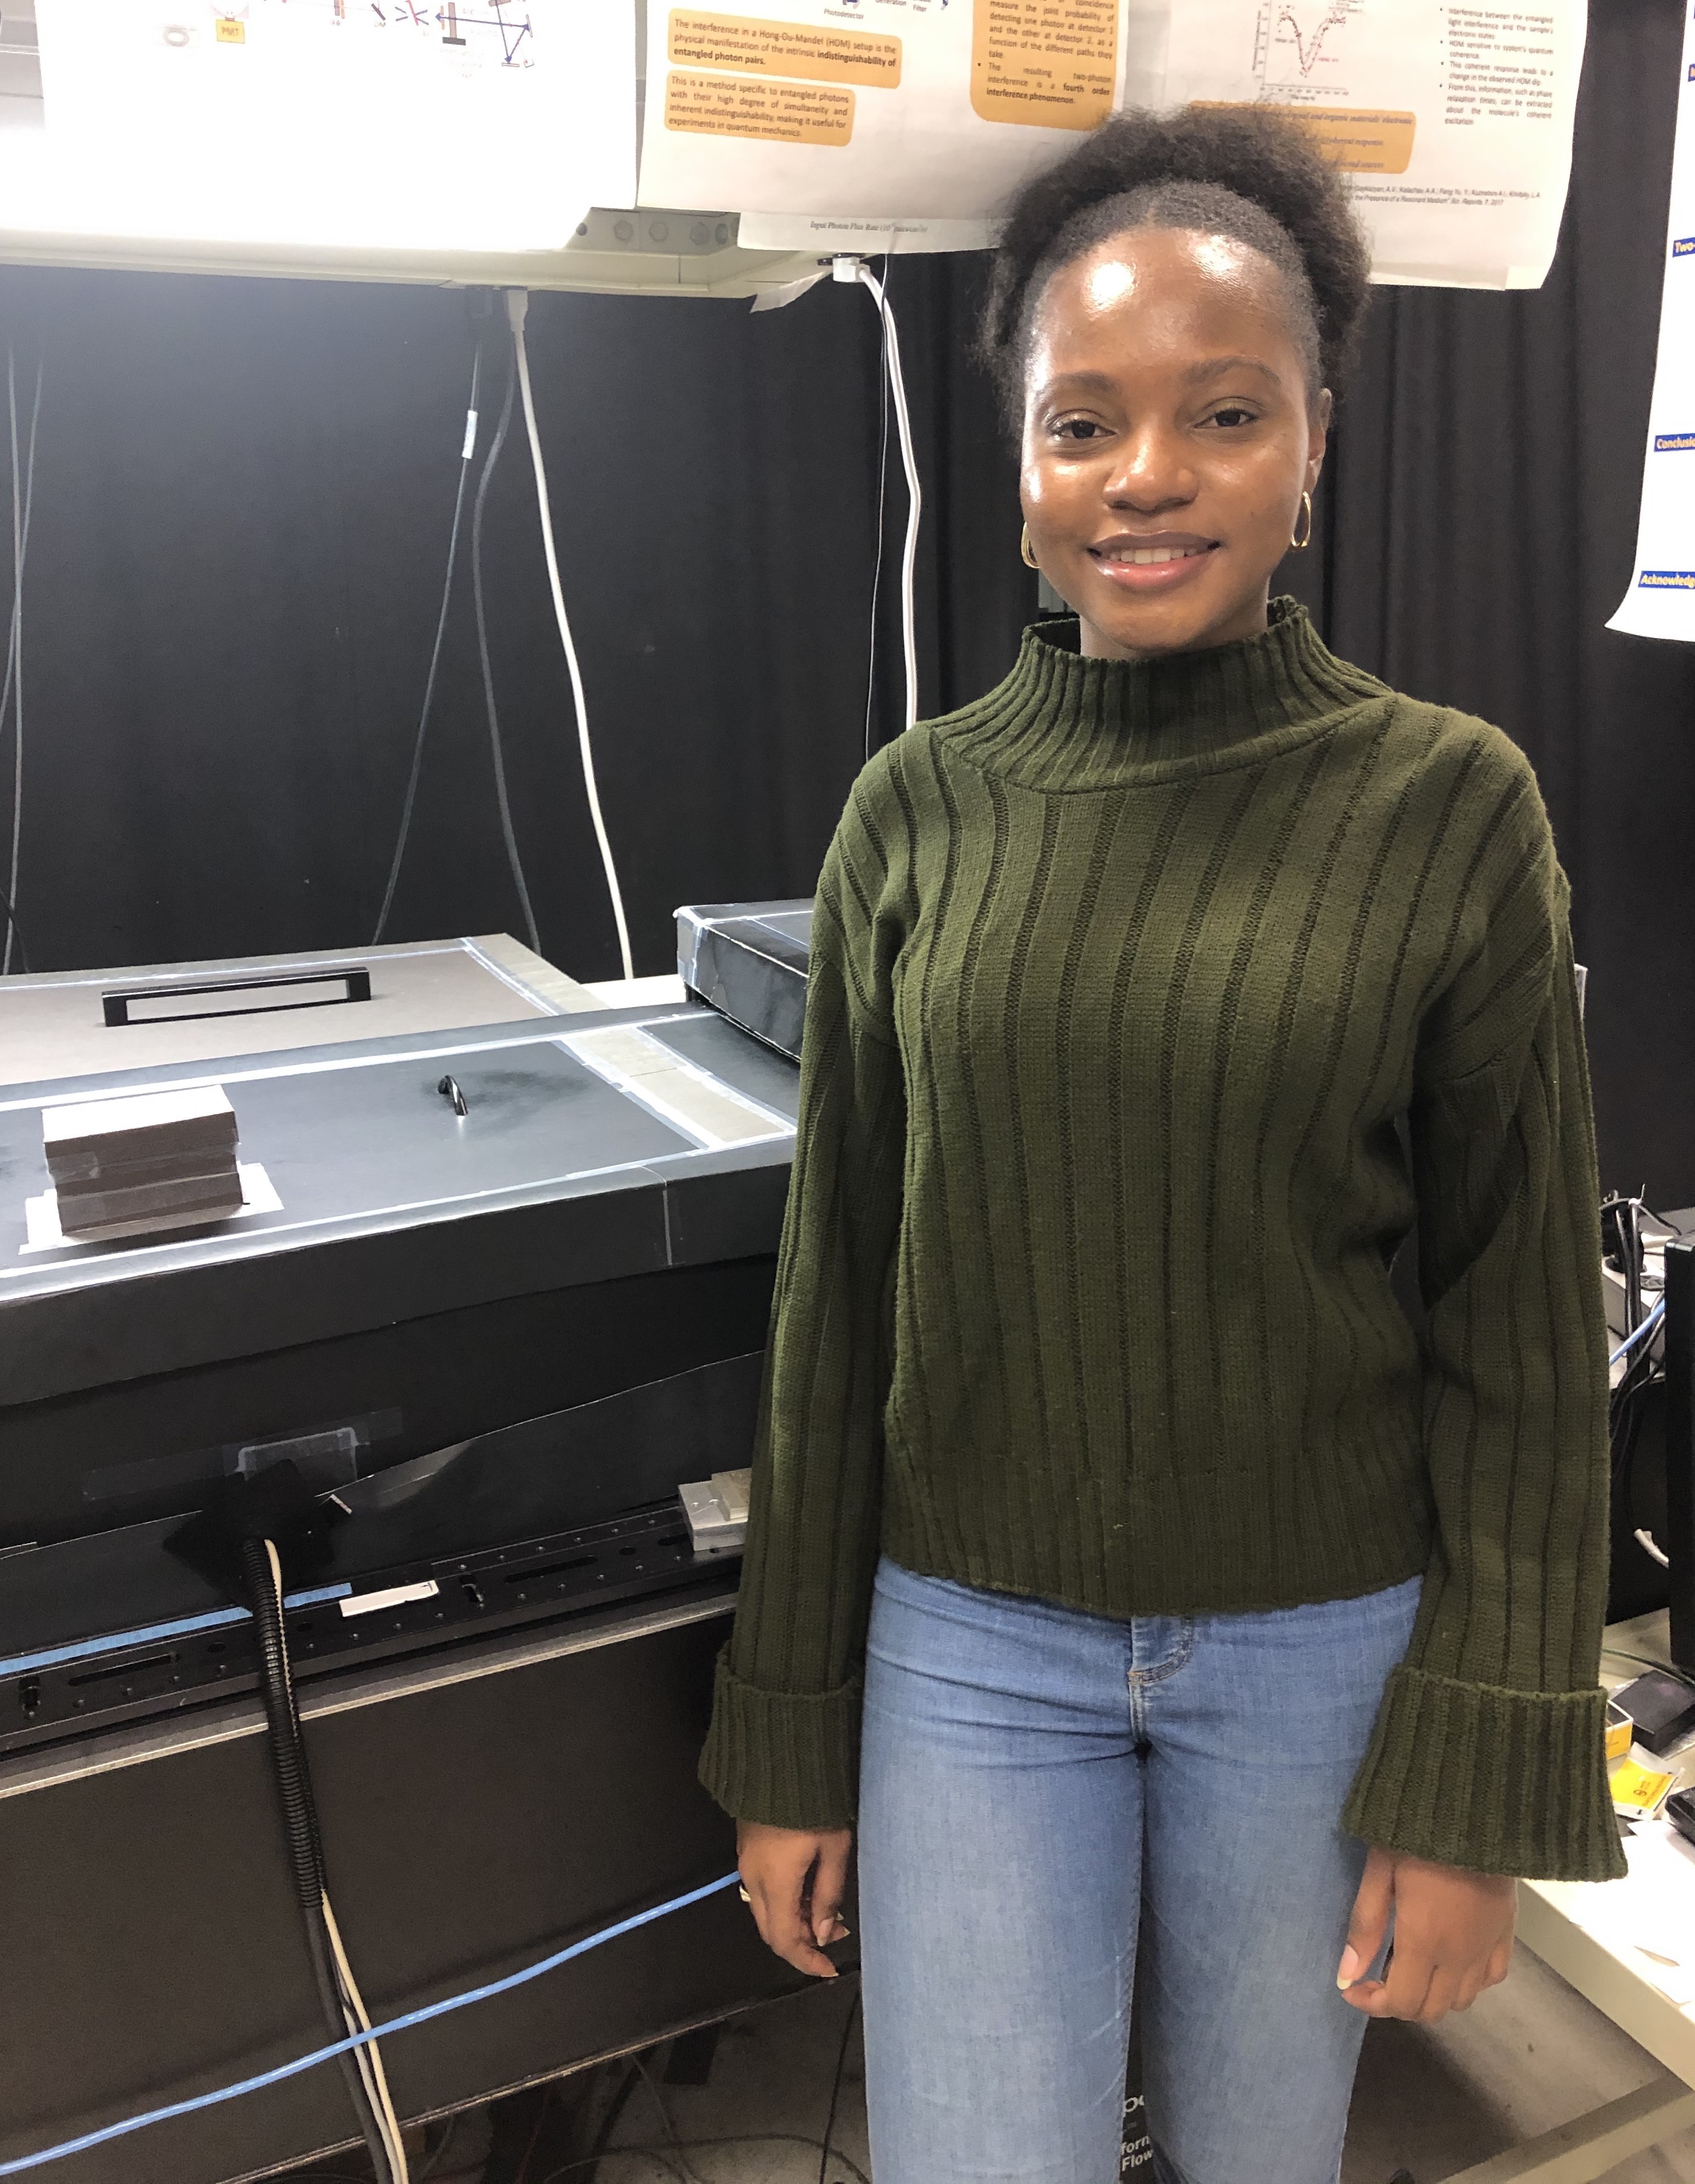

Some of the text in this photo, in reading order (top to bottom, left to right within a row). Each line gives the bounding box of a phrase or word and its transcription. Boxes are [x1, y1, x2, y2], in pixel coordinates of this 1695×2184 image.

[990, 1, 1018, 10] measure
[1065, 11, 1101, 21] probability
[1076, 0, 1113, 10] coincidence
[824, 8, 864, 19] Photodetector
[990, 12, 1021, 25] detecting
[1041, 19, 1064, 28] photon
[1078, 24, 1106, 33] detector
[221, 26, 239, 36] PMT
[675, 19, 689, 28] The
[692, 21, 739, 34] interference
[742, 27, 749, 35] in
[759, 29, 824, 45] Hong-Ou-Mandel
[826, 38, 850, 50] (HOM)
[853, 43, 873, 51] setup
[876, 44, 881, 52] is
[884, 44, 896, 54] the
[1056, 33, 1083, 43] detector
[674, 34, 705, 44] physical
[707, 37, 759, 51] manifestation
[771, 45, 784, 54] the
[786, 47, 815, 57] intrinsic
[817, 50, 886, 67] indistinguishability
[888, 58, 896, 66] of
[674, 48, 713, 59] entangled
[715, 52, 743, 62] photon
[990, 37, 1017, 47] function
[1031, 42, 1041, 51] the
[1045, 44, 1073, 54] different
[1098, 51, 1112, 59] they
[989, 62, 1001, 71] The
[1023, 68, 1052, 78] resulting
[1450, 73, 1469, 82] change
[672, 76, 687, 85] This
[706, 81, 736, 91] method
[739, 84, 766, 94] specific
[780, 89, 816, 100] entangled
[819, 93, 849, 103] photons
[988, 77, 1028, 86] interference
[1063, 83, 1084, 92] fourth
[986, 88, 1027, 99] interference
[694, 92, 712, 101] their
[717, 95, 733, 105] high
[739, 97, 765, 108] degree
[771, 100, 779, 108] of
[784, 103, 829, 115] simultaneity
[670, 104, 702, 114] inherent
[777, 115, 803, 126] making
[812, 119, 834, 127] useful
[836, 119, 846, 128] for
[669, 118, 715, 128] experiments
[726, 123, 759, 133] quantum
